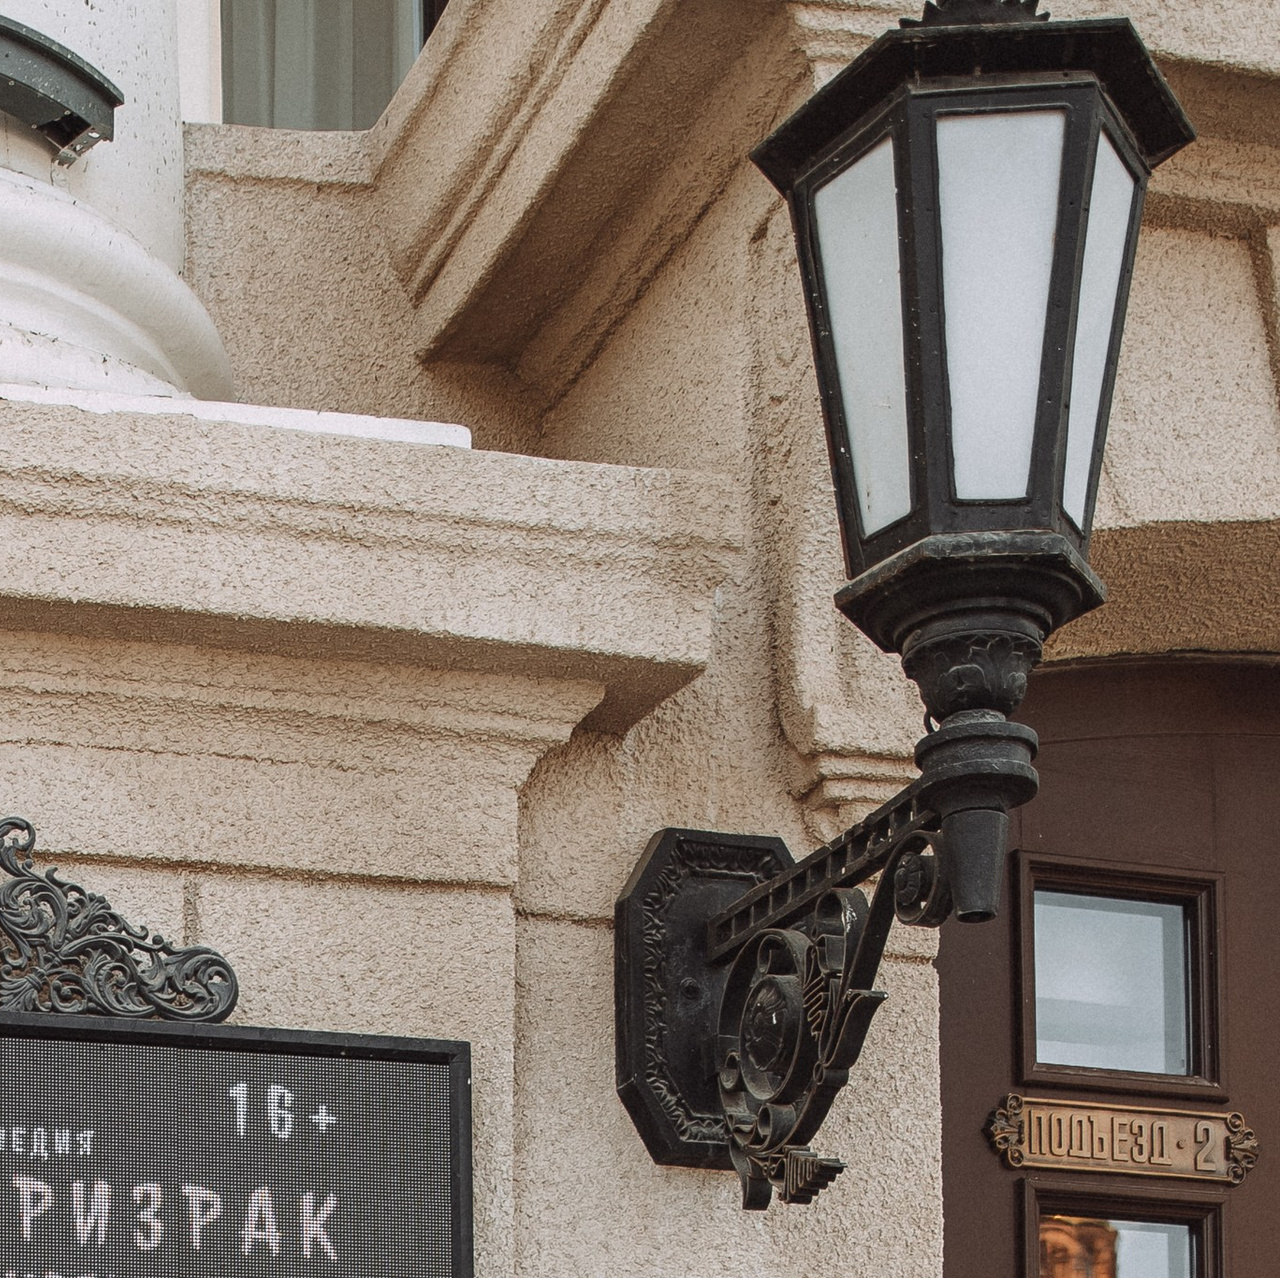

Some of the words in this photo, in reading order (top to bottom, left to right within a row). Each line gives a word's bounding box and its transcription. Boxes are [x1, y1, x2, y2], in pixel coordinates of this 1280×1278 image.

[229, 1083, 337, 1140] 16+
[1028, 1108, 1173, 1166] ПОДЪЕЗД
[1194, 1119, 1219, 1172] 2
